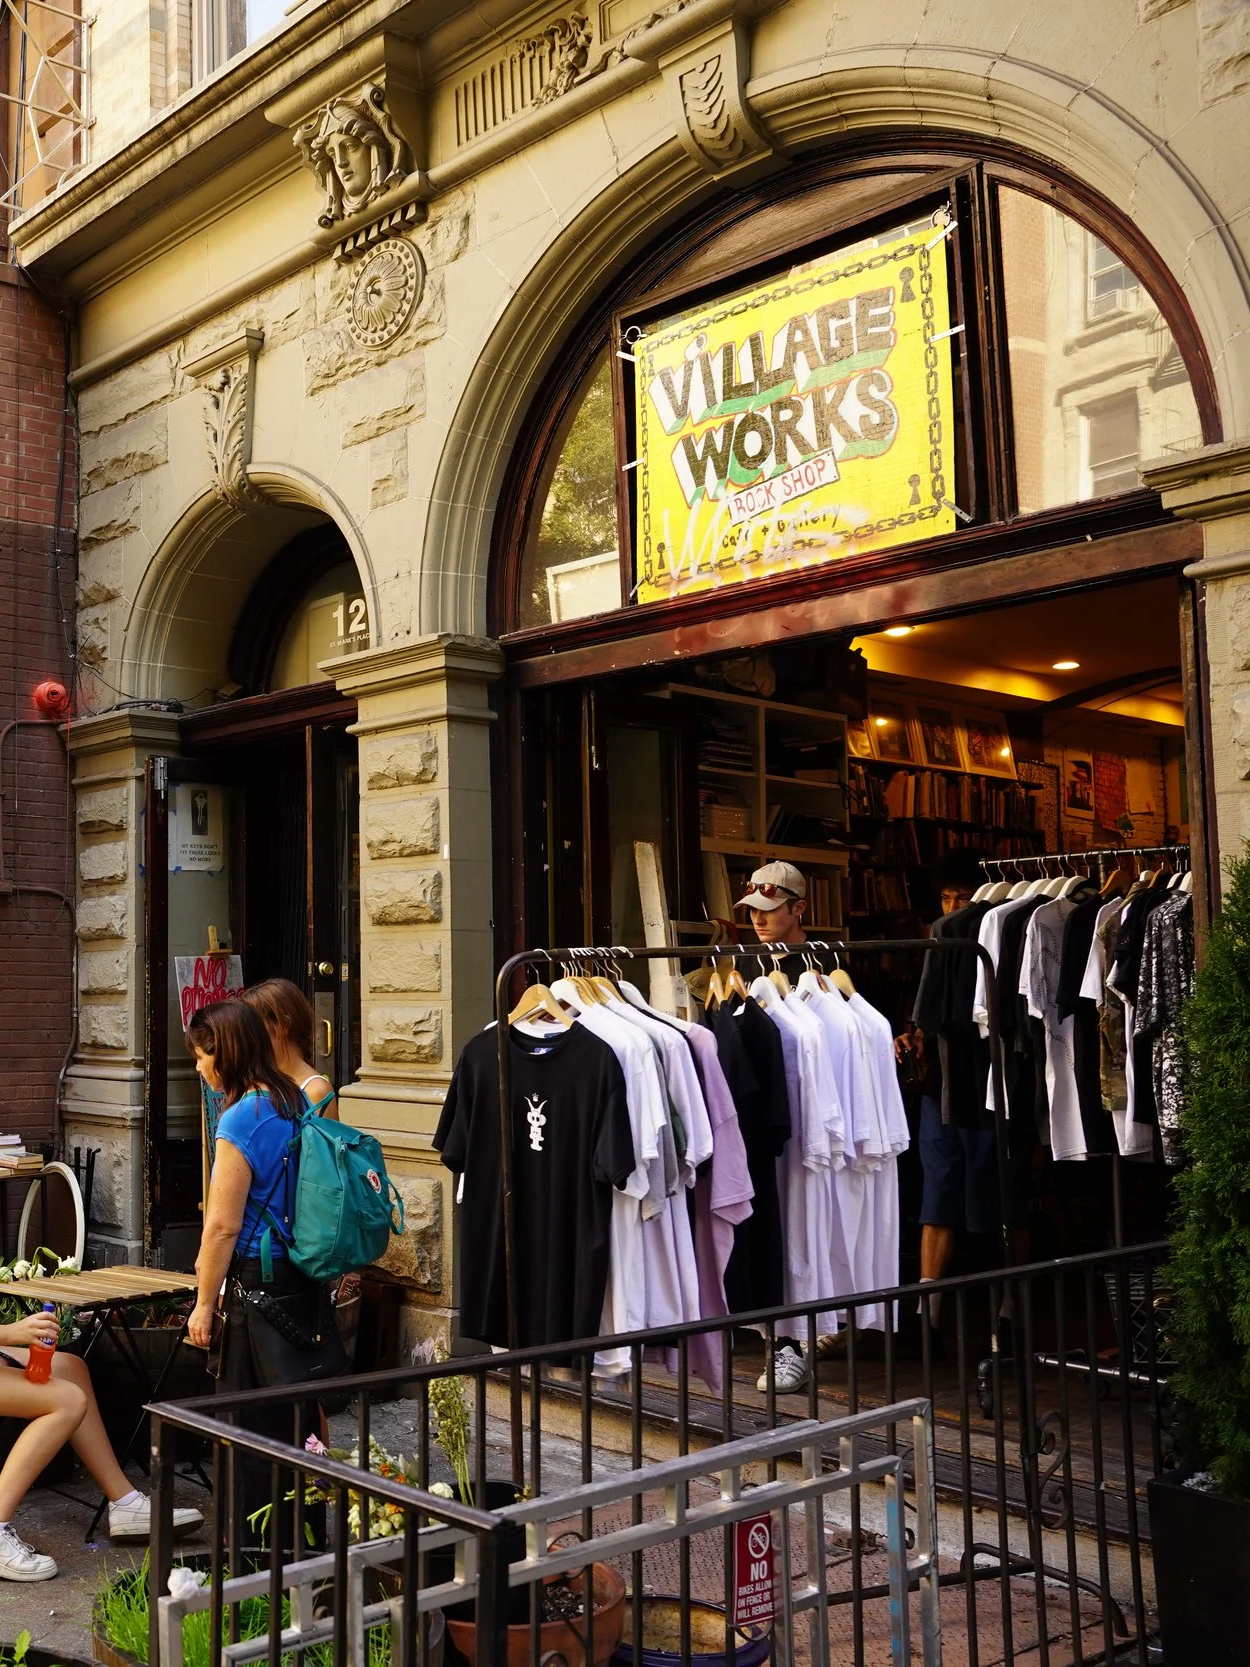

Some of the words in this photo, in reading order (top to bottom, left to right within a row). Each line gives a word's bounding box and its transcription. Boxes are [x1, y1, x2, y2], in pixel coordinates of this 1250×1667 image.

[649, 287, 897, 435] VILLAGE
[672, 368, 898, 507] WORKS
[781, 458, 826, 497] SHOP
[332, 598, 366, 636] 12
[194, 957, 226, 989] NO
[750, 1560, 768, 1581] NO
[738, 1586, 754, 1597] BIKES
[755, 1580, 772, 1592] ALLOW
[738, 1598, 745, 1608] ON
[746, 1594, 762, 1606] FENCE
[763, 1592, 770, 1601] OR
[737, 1608, 750, 1619] WILL
[752, 1602, 773, 1616] REMOVE
